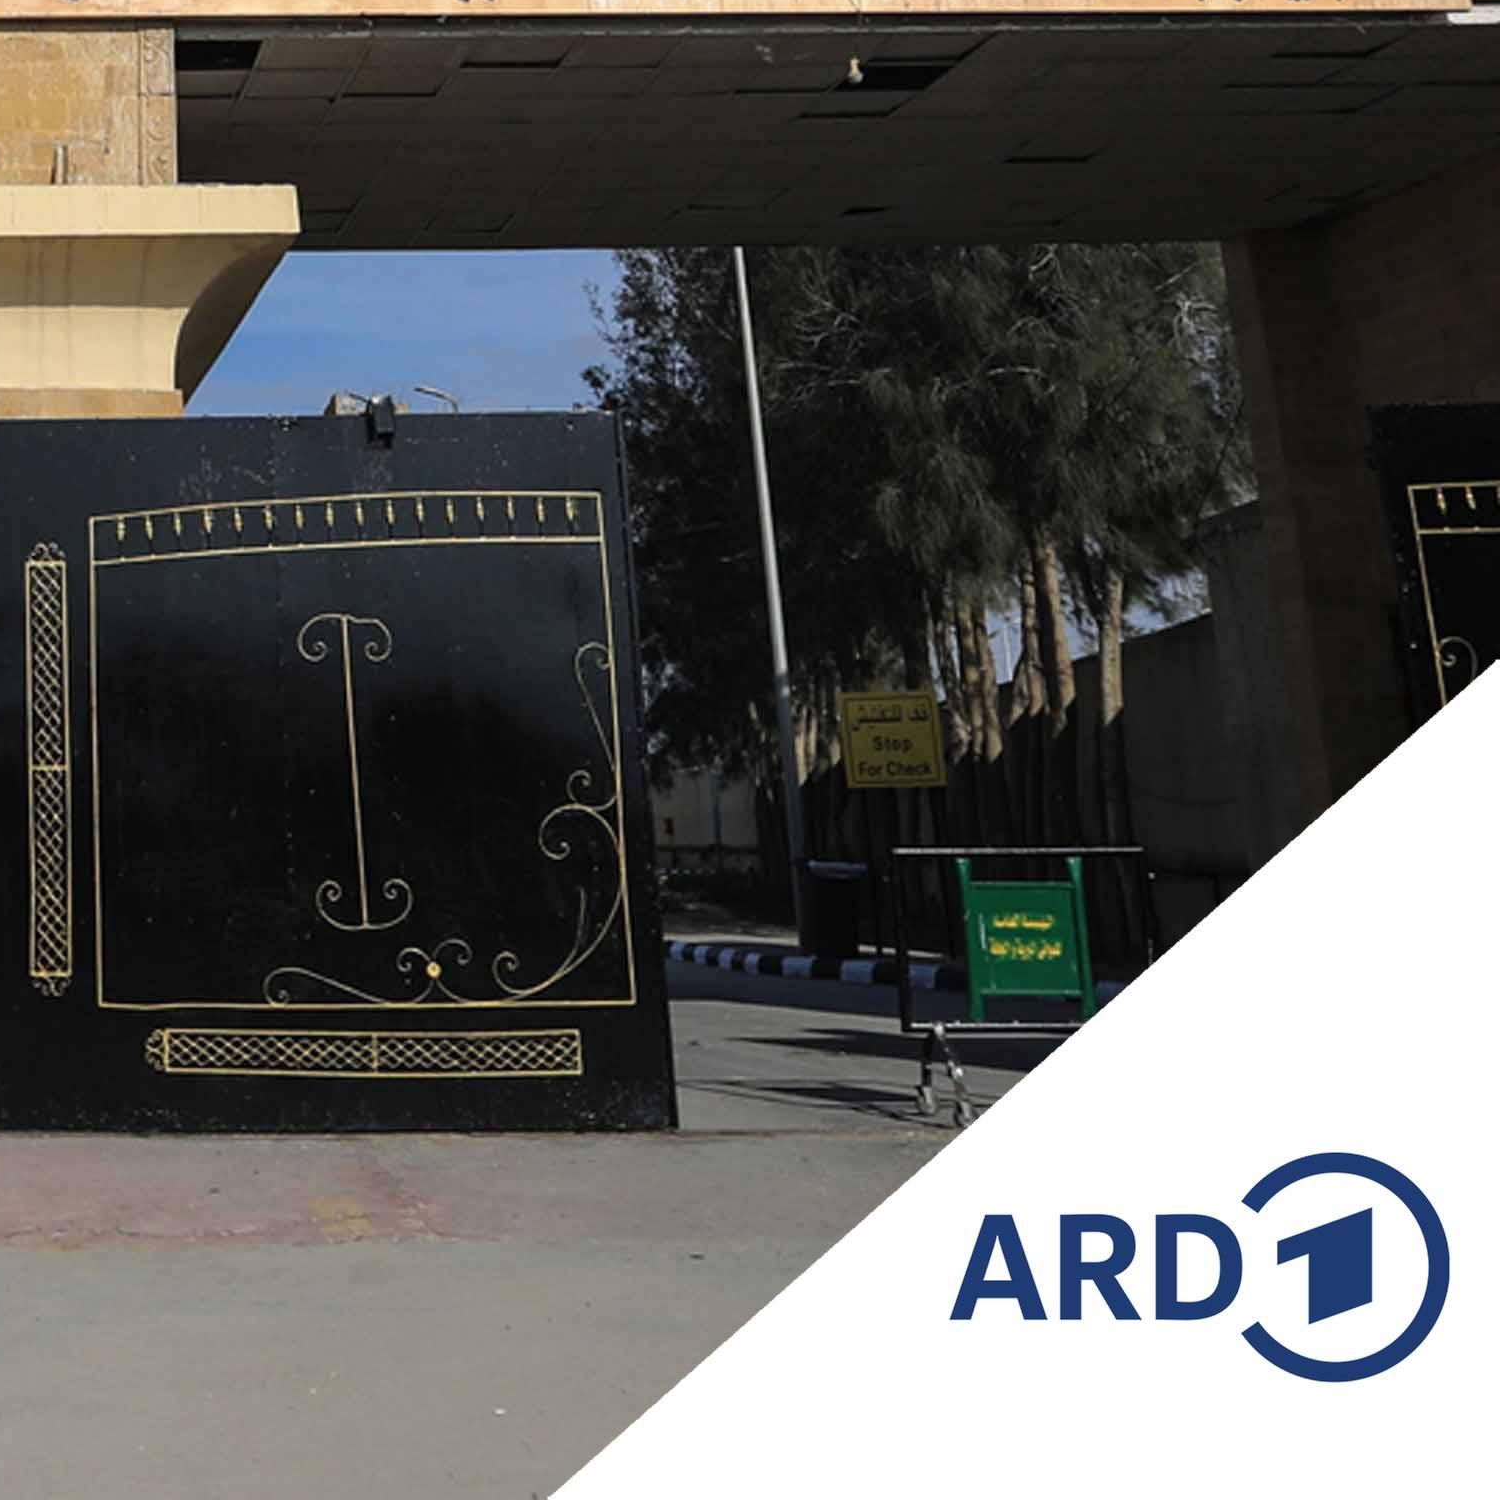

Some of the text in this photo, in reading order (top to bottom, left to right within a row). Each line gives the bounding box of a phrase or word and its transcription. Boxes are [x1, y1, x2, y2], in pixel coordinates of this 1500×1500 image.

[873, 735, 914, 753] Stop
[859, 760, 931, 777] For Check
